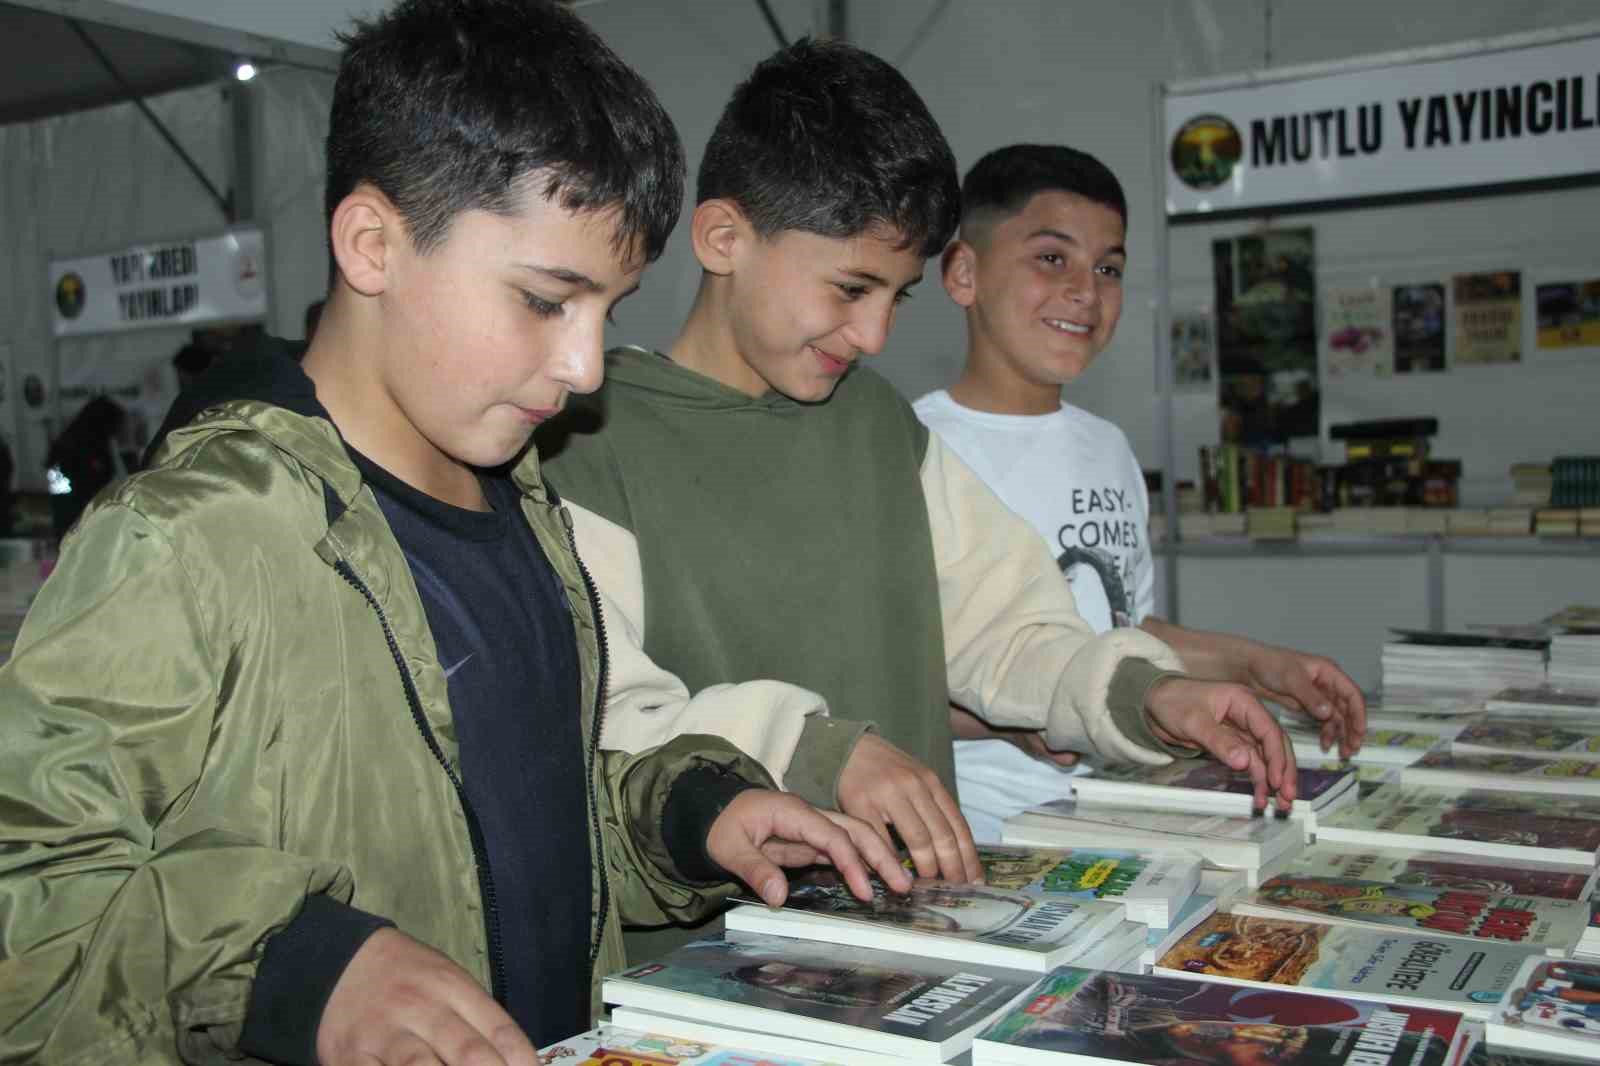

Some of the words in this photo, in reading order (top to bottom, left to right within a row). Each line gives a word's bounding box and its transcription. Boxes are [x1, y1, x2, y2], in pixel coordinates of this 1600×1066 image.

[1251, 104, 1381, 167] MUTLU
[1398, 74, 1600, 148] YAYINCIL
[1058, 520, 1138, 550] COMES
[881, 972, 993, 1026] ALPARSLAN
